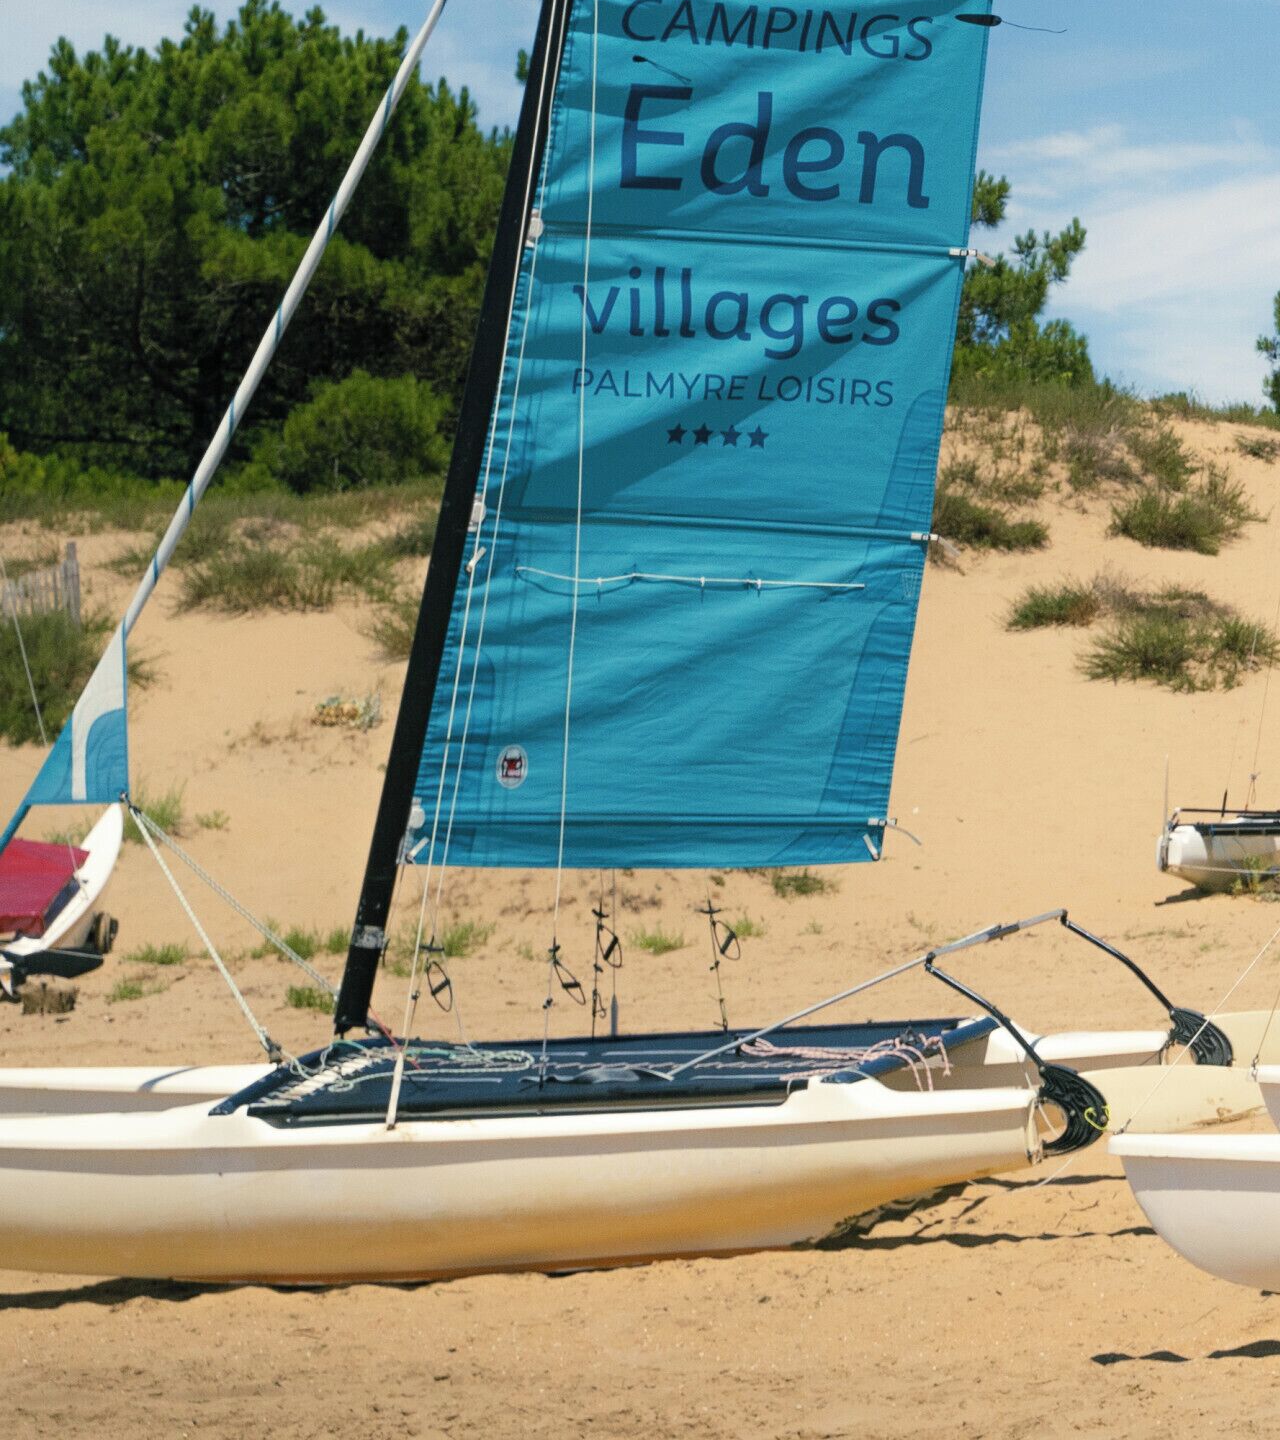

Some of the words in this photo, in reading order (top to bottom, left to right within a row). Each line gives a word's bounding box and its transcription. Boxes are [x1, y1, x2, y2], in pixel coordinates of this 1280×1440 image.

[620, 83, 930, 209] Eden
[572, 266, 901, 360] villages
[571, 367, 748, 402] PALMYRE
[757, 373, 894, 407] LOISIRS
